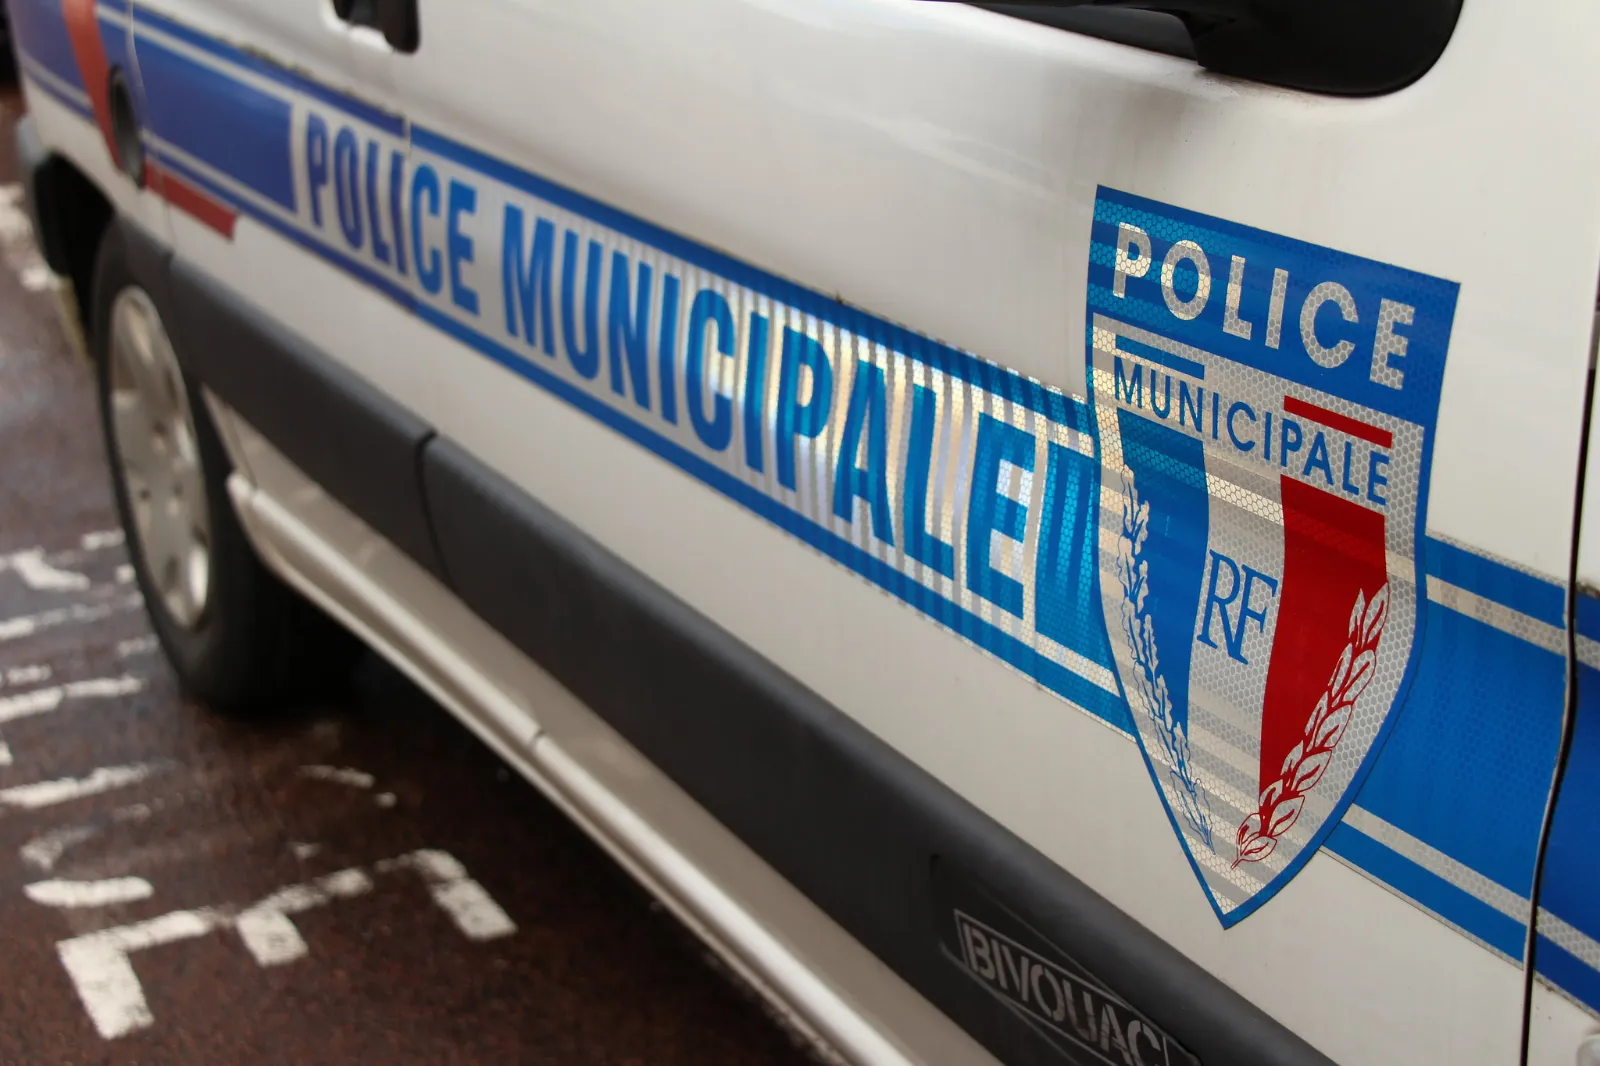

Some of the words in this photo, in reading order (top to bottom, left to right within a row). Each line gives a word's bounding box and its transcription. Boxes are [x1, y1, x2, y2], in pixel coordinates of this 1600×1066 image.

[306, 110, 480, 317] POLICE
[502, 202, 1036, 620] MUNICIPALE
[1113, 222, 1415, 391] POLICE
[1114, 355, 1390, 506] MUNICIPALE
[1197, 549, 1279, 665] RF
[962, 921, 1162, 1066] BIVOUAC
